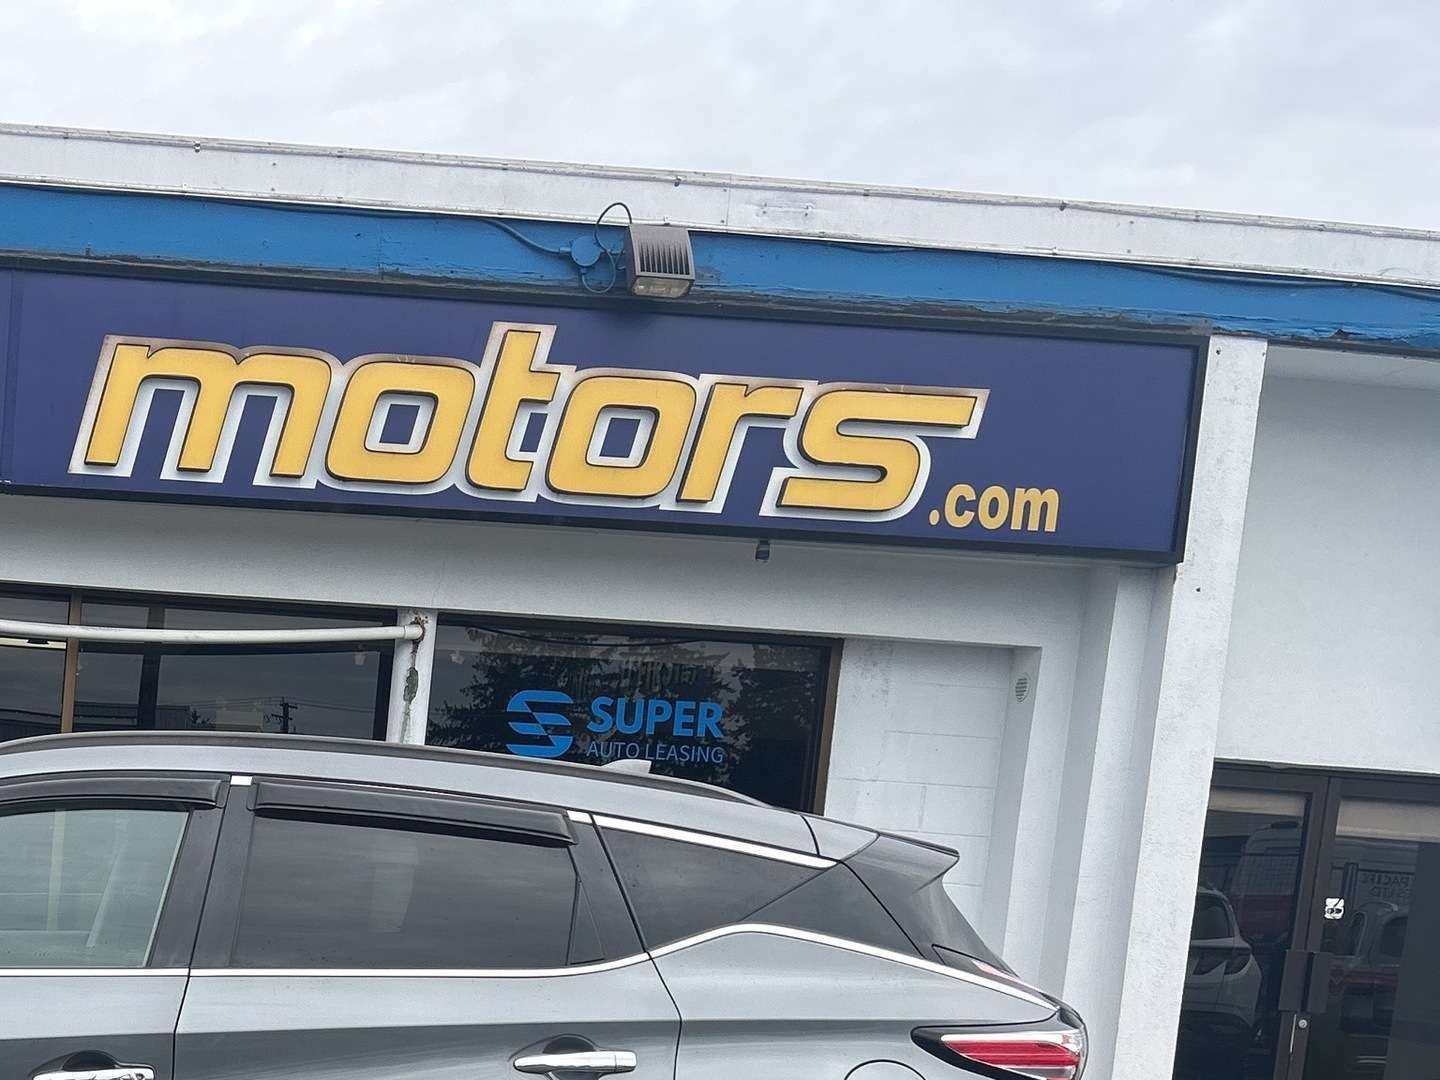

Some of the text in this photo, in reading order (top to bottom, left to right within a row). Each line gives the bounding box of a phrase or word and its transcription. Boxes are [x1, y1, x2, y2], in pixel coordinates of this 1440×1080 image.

[68, 321, 990, 523] motors
[928, 484, 1059, 533] .com
[587, 696, 724, 738] SUPER
[587, 741, 724, 763] AUTO LEASING
